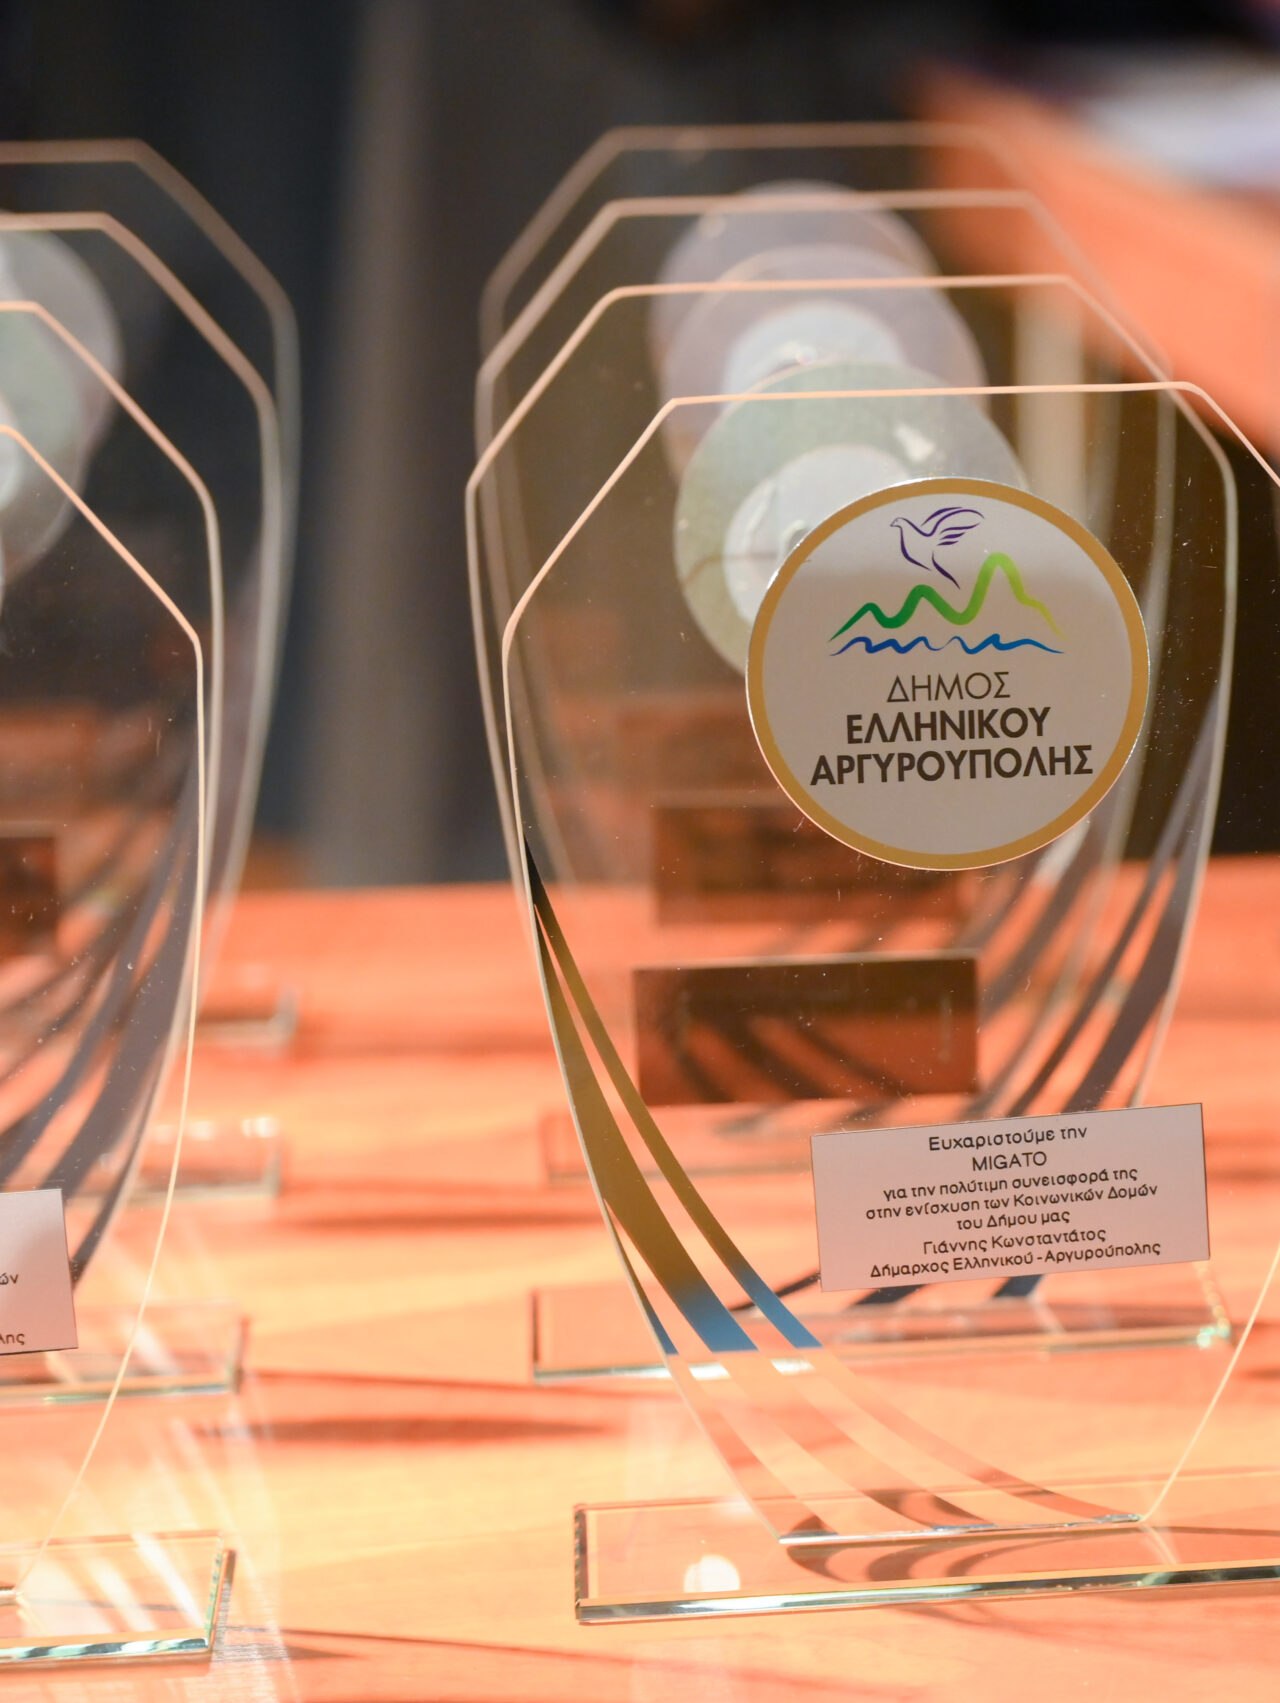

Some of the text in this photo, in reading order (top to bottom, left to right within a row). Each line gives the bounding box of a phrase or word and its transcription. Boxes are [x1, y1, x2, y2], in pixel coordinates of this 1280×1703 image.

[887, 672, 1010, 702] ΔΗΜΟΣ
[847, 707, 1050, 744] ΕΛΛΗΝΙΚΟΥ
[810, 745, 1093, 785] ΑΡΓΥΡΟΥΠΟΛΗΣ
[928, 1127, 1088, 1152] Ευχαριστούμε την
[971, 1150, 1048, 1172] MIGATO
[882, 1168, 1139, 1203] για την πολύτιμη συνεισφορά της
[865, 1183, 1158, 1221] στην ενίσχυση των Κοινωνικών Δομών
[956, 1210, 1071, 1231] του Δήμου μας
[922, 1228, 1107, 1255] Γιάννης Κωνσταντάτος
[869, 1260, 950, 1279] Δήμαρχος
[952, 1251, 1034, 1271] Ελληνικού
